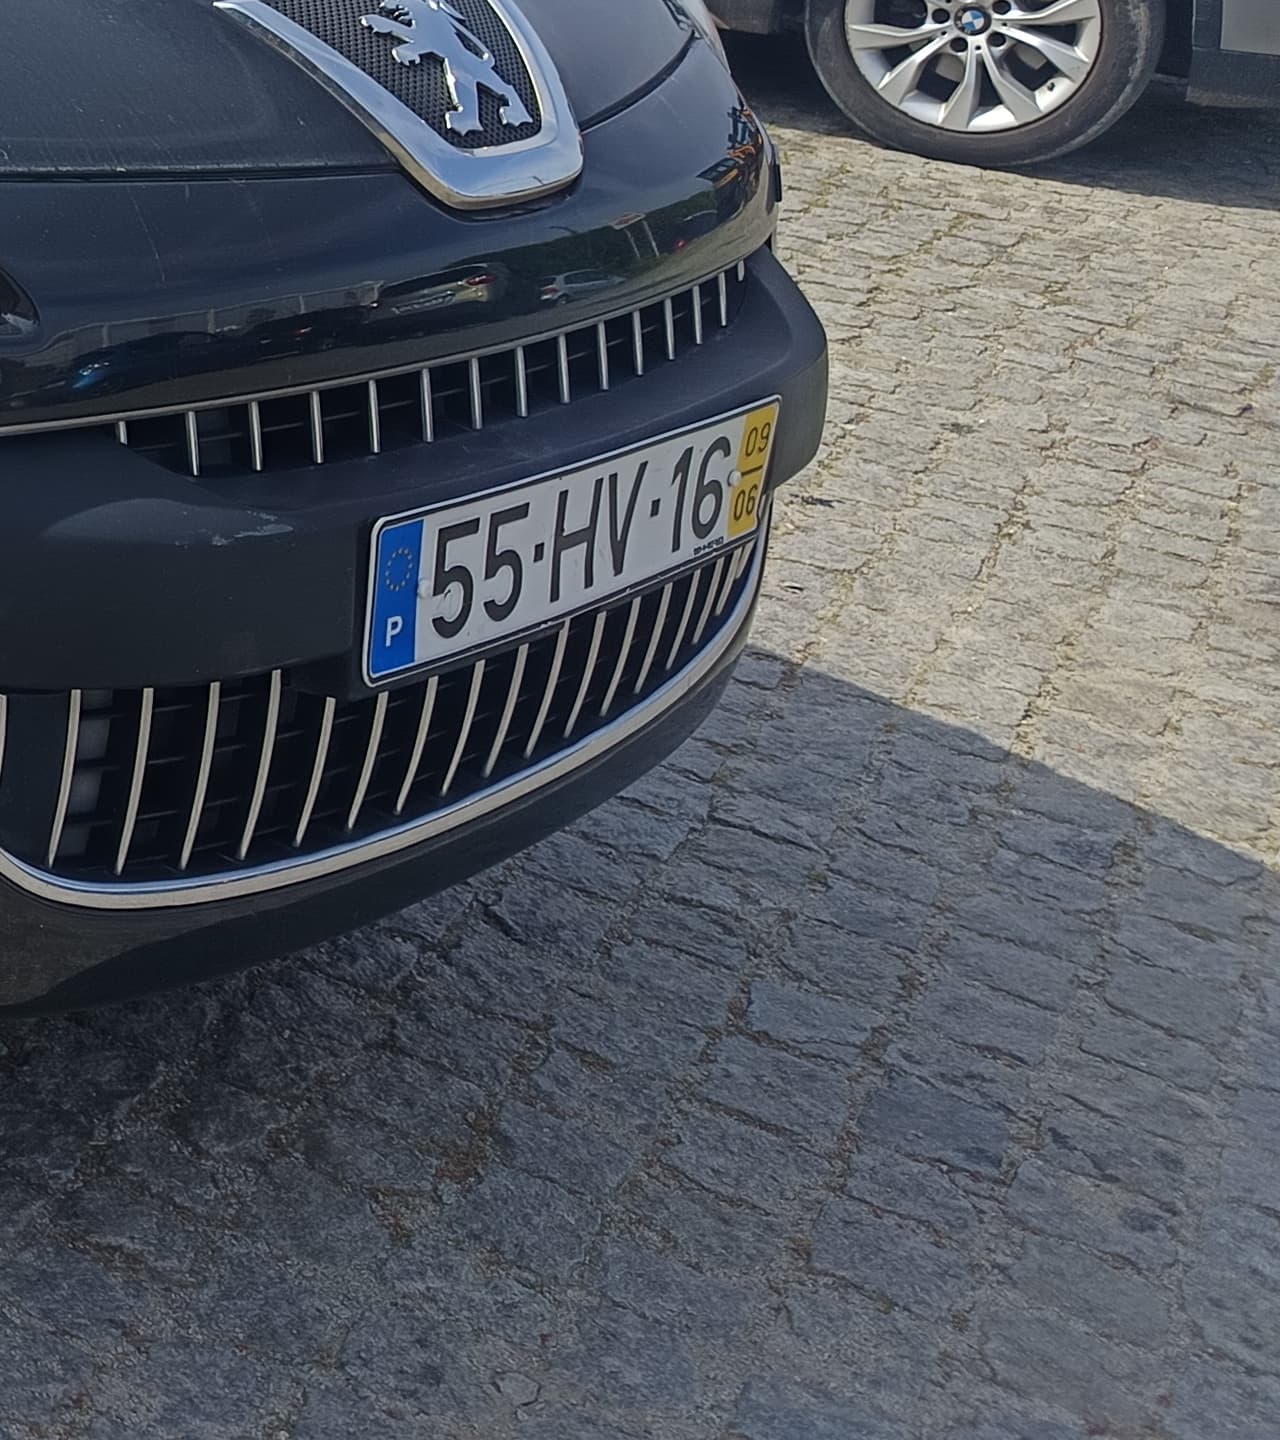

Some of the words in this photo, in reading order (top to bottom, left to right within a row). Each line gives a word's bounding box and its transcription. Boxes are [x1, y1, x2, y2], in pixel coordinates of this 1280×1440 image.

[745, 426, 772, 458] 09
[733, 484, 758, 521] 06
[385, 615, 403, 647] P
